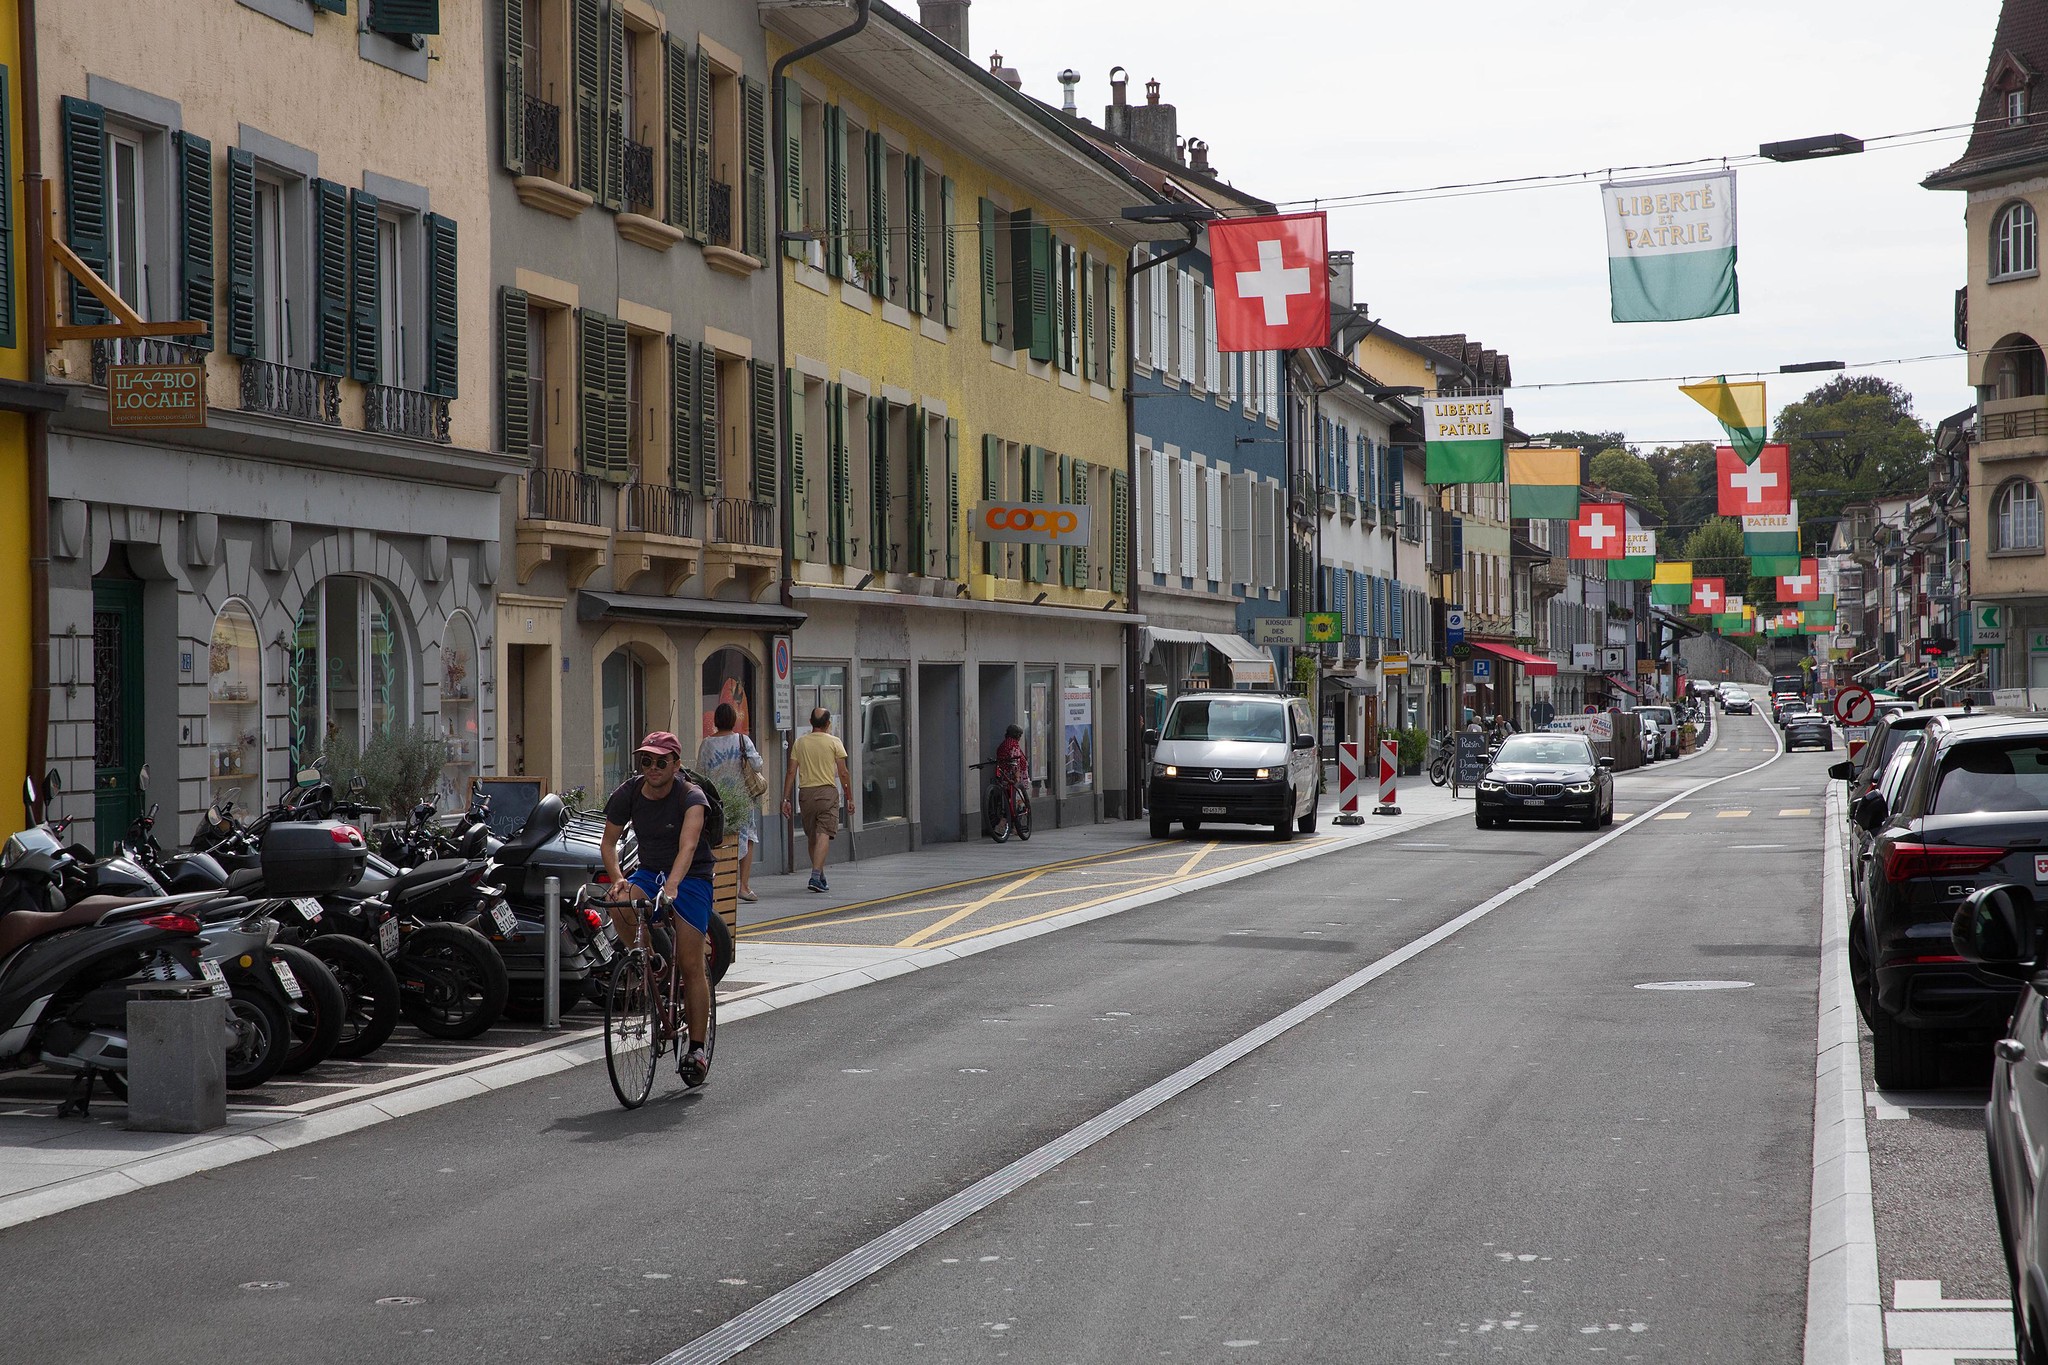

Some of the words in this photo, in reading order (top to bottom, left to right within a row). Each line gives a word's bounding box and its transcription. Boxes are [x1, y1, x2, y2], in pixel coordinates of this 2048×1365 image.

[1616, 183, 1716, 217] LIBERTÉ
[1658, 214, 1674, 226] ET
[1624, 222, 1713, 249] PATRIE
[163, 372, 197, 389] BIO
[116, 391, 196, 409] LOCALE
[1434, 399, 1493, 417] LIBERTÉ
[1439, 422, 1491, 436] PATRIE
[985, 507, 1078, 539] coop
[1747, 516, 1789, 527] PATRIE
[1264, 618, 1293, 626] KIOSQUE
[1978, 631, 2000, 639] 24/24
[1476, 662, 1485, 674] P
[302, 901, 321, 918] 6173
